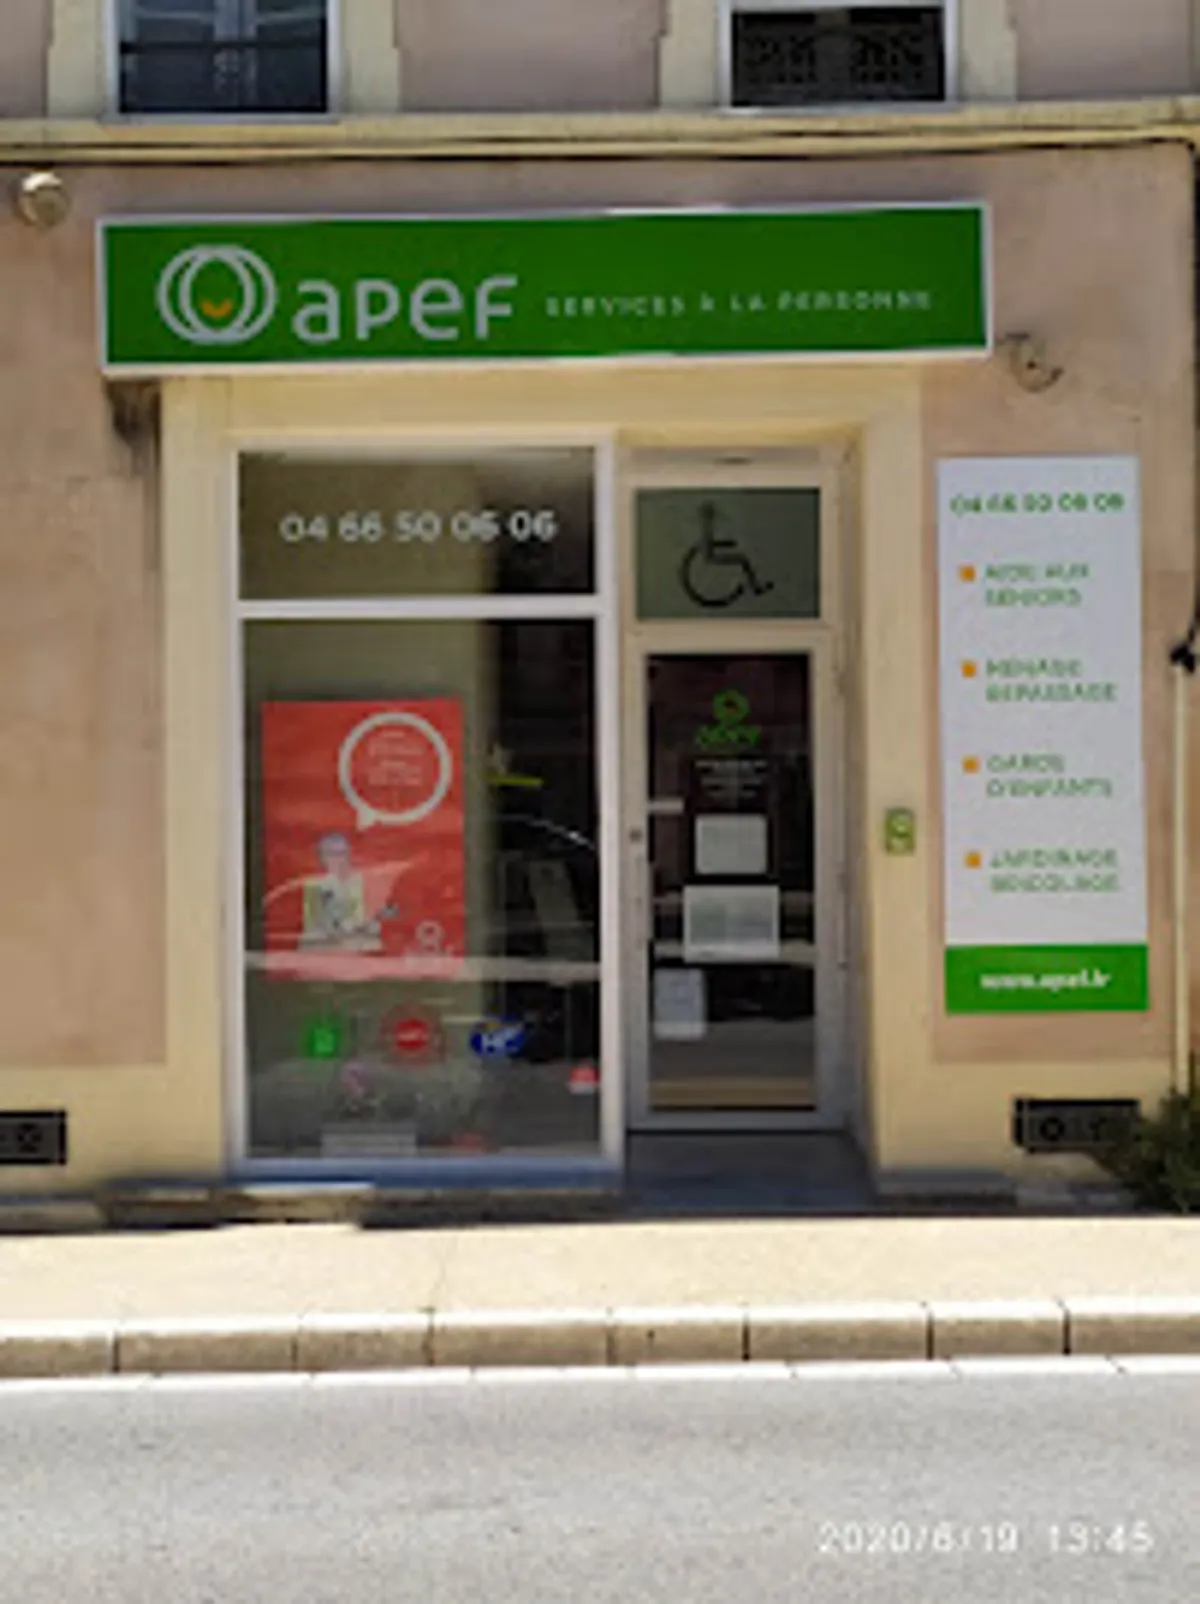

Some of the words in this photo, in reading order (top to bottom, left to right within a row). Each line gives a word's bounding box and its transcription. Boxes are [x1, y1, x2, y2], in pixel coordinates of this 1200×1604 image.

[545, 295, 686, 318] SERVICES
[730, 292, 767, 312] LA
[279, 513, 329, 543] 04
[338, 511, 383, 543] 66
[395, 511, 443, 543] 50
[508, 510, 558, 543] 06
